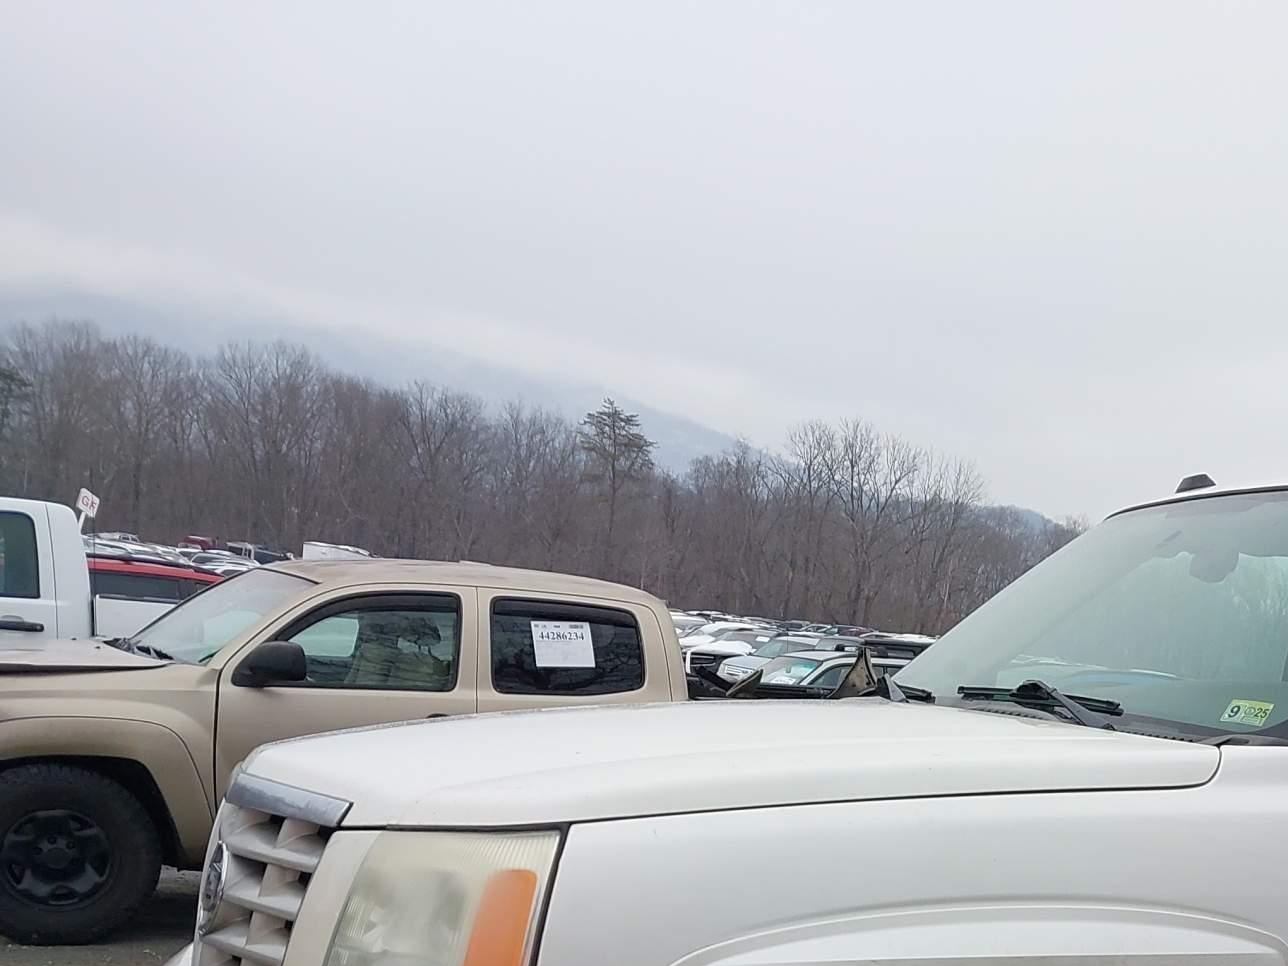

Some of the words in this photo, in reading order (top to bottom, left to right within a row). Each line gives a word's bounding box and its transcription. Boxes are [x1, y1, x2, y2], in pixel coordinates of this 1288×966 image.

[539, 631, 584, 641] 44286234
[1228, 705, 1241, 718] 9
[1254, 707, 1270, 719] 25
